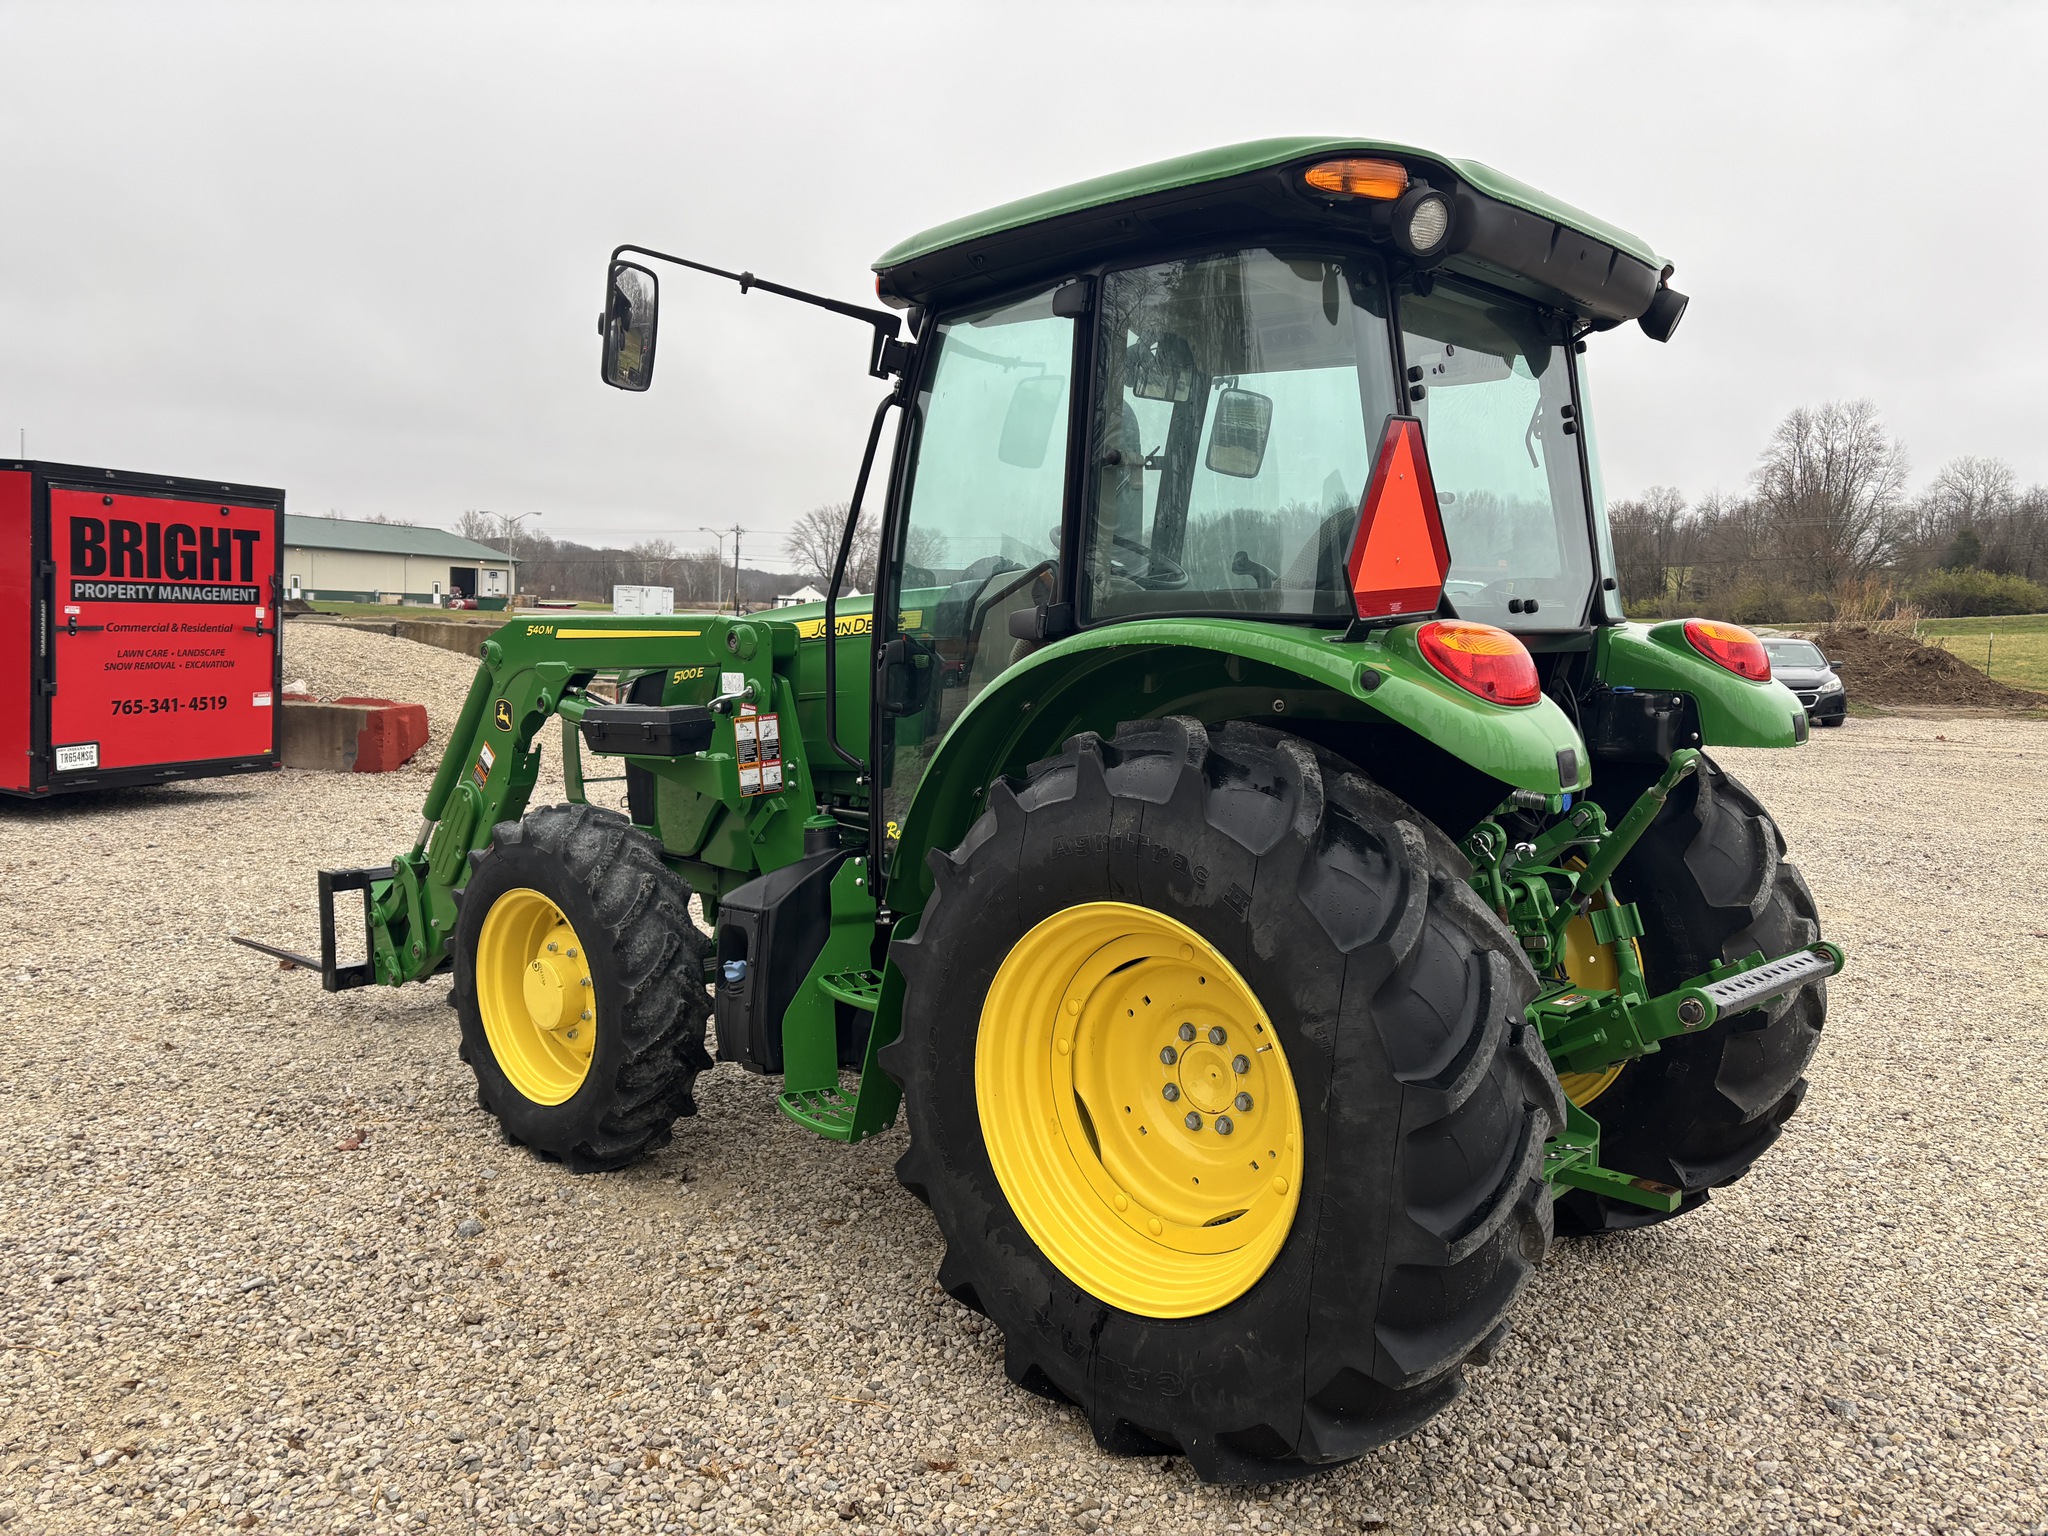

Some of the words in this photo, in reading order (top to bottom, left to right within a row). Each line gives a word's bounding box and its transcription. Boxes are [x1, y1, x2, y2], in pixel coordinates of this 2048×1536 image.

[69, 516, 260, 582] BRIGHT
[74, 583, 155, 600] PROPERTY
[158, 585, 257, 602] MANAGEMENT
[106, 623, 170, 633] Commercial
[171, 623, 179, 633] &
[180, 623, 234, 633] Residential
[117, 649, 144, 658] LAWN
[145, 649, 169, 658] CARE
[177, 648, 226, 657] LANDSCAPE
[104, 662, 133, 671] SNOW
[134, 661, 176, 670] REMOVAL
[185, 660, 235, 669] EXCAVATION
[1050, 831, 1211, 886] AgriTrac
